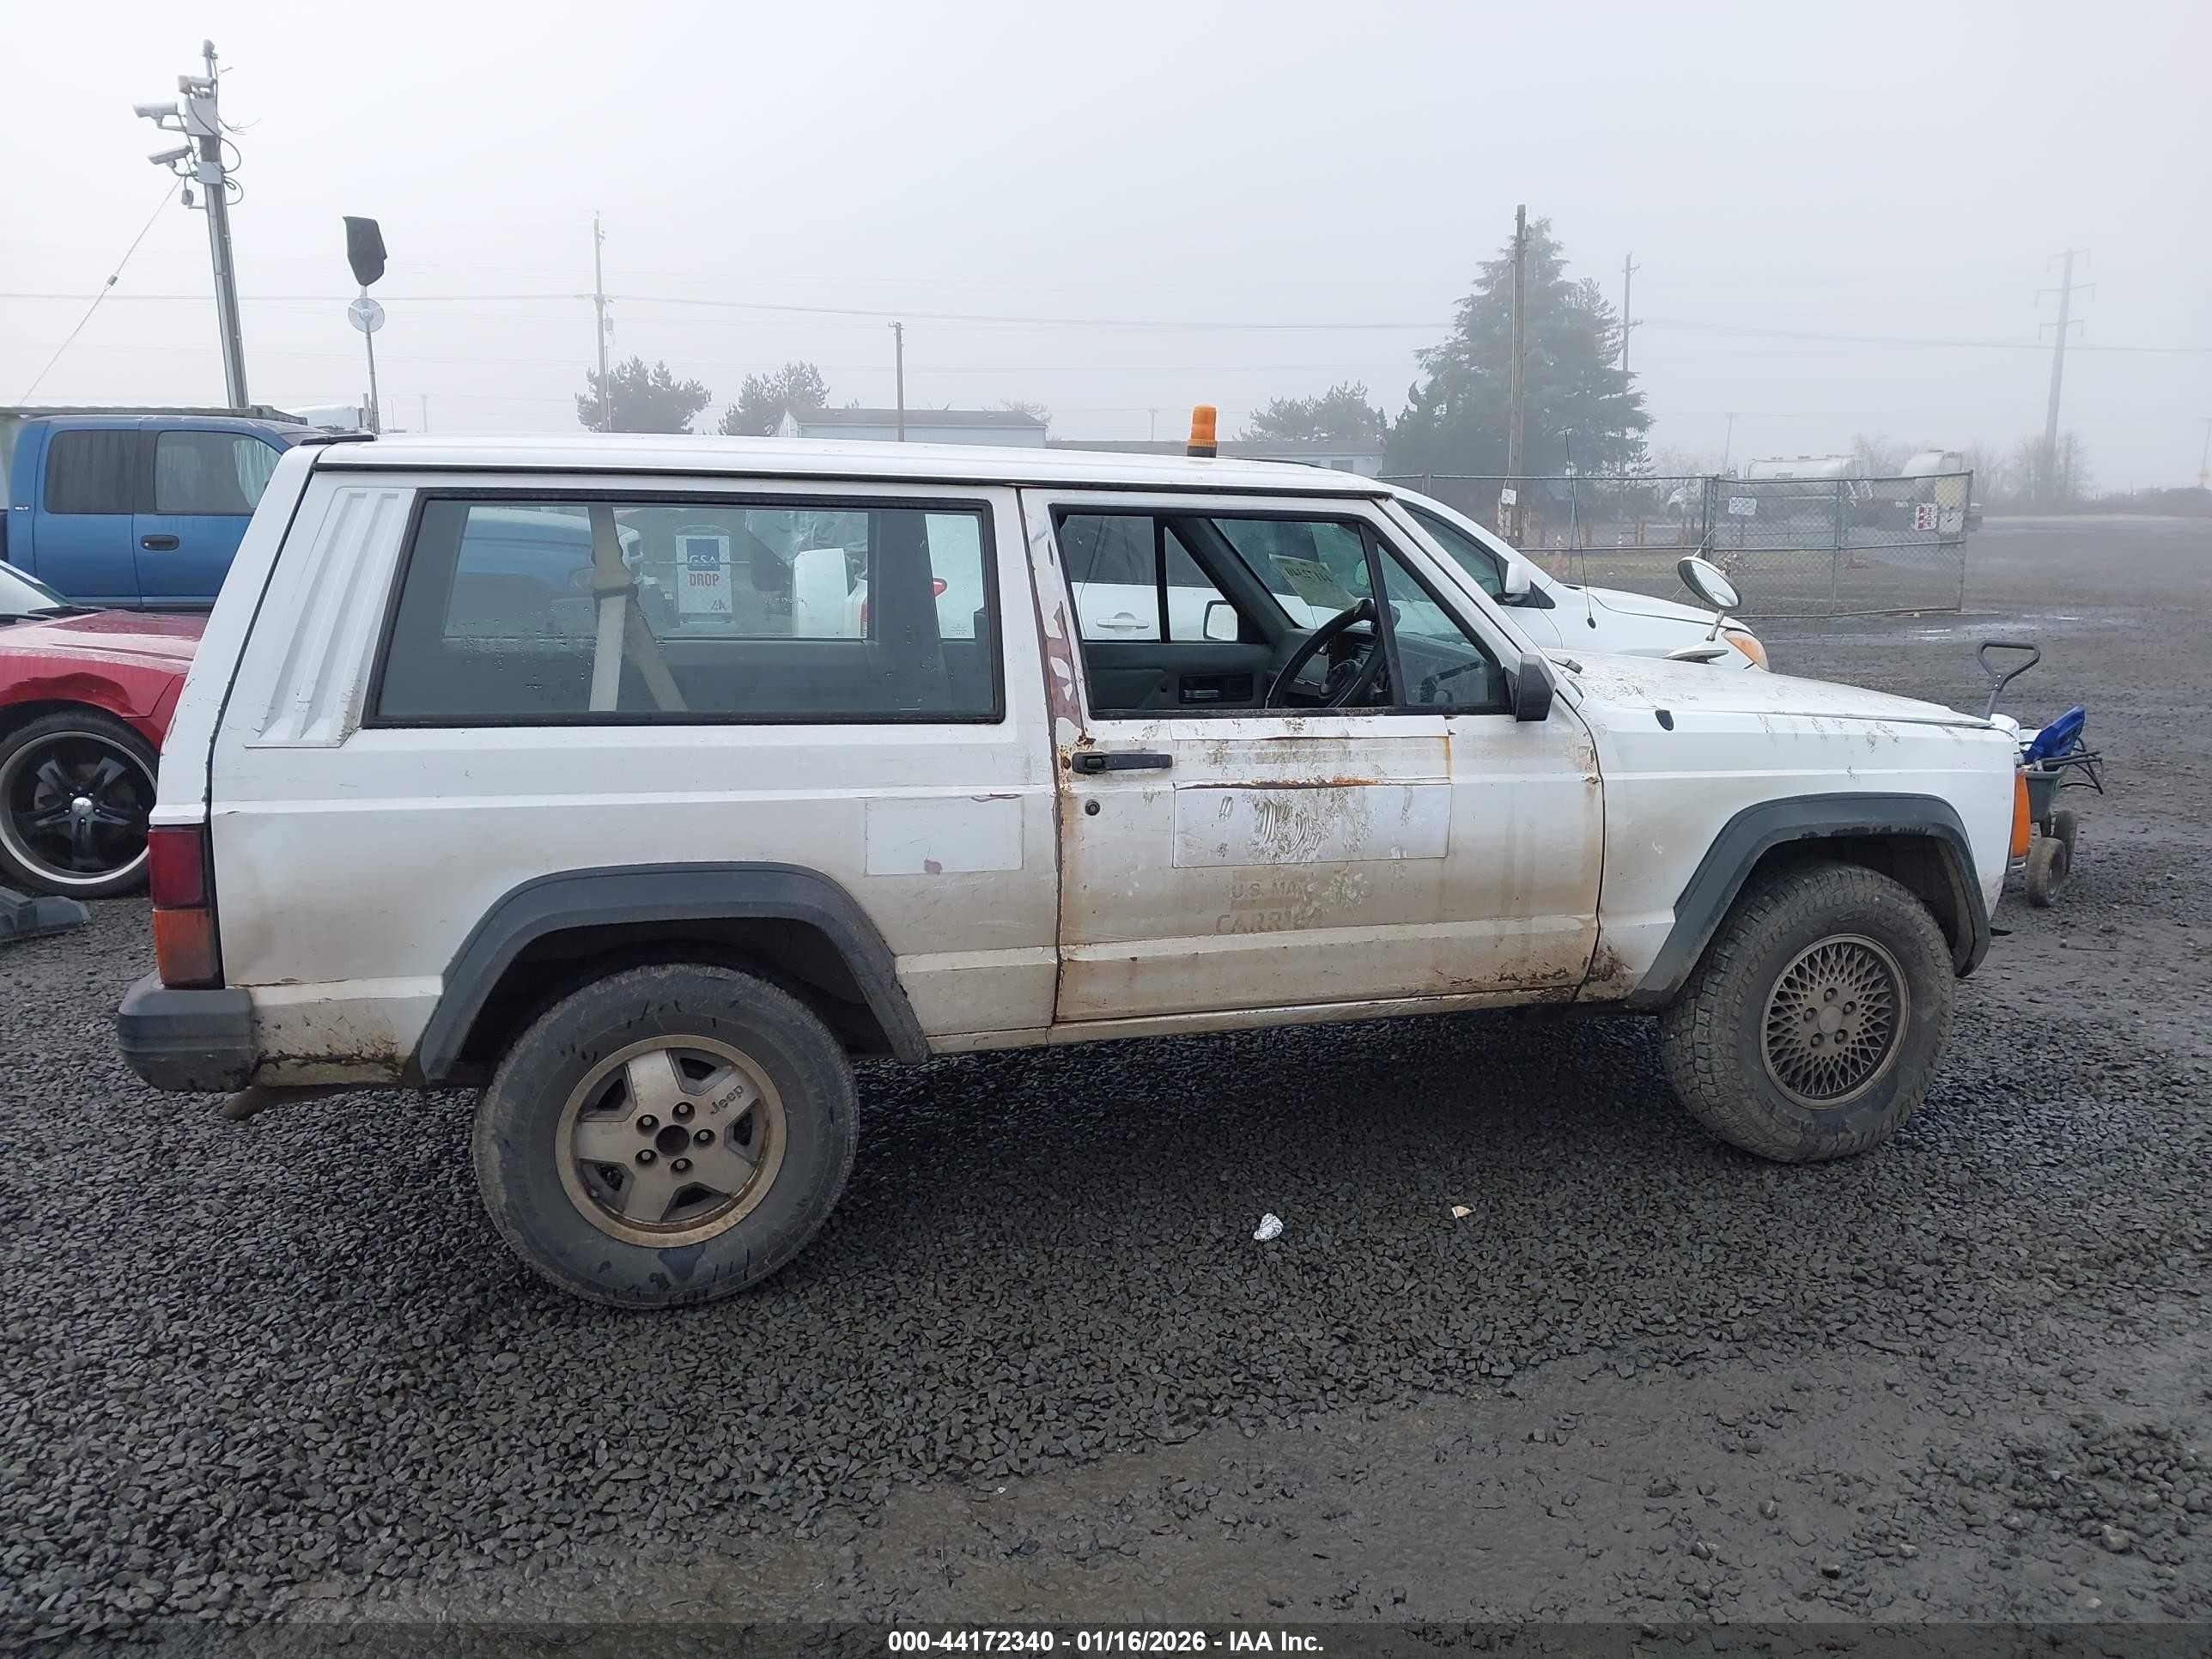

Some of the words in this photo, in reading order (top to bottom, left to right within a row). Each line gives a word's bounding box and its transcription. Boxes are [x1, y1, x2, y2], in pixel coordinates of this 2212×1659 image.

[690, 555, 717, 566] GSA
[690, 574, 720, 586] DROP
[710, 1085, 744, 1115] Jeep
